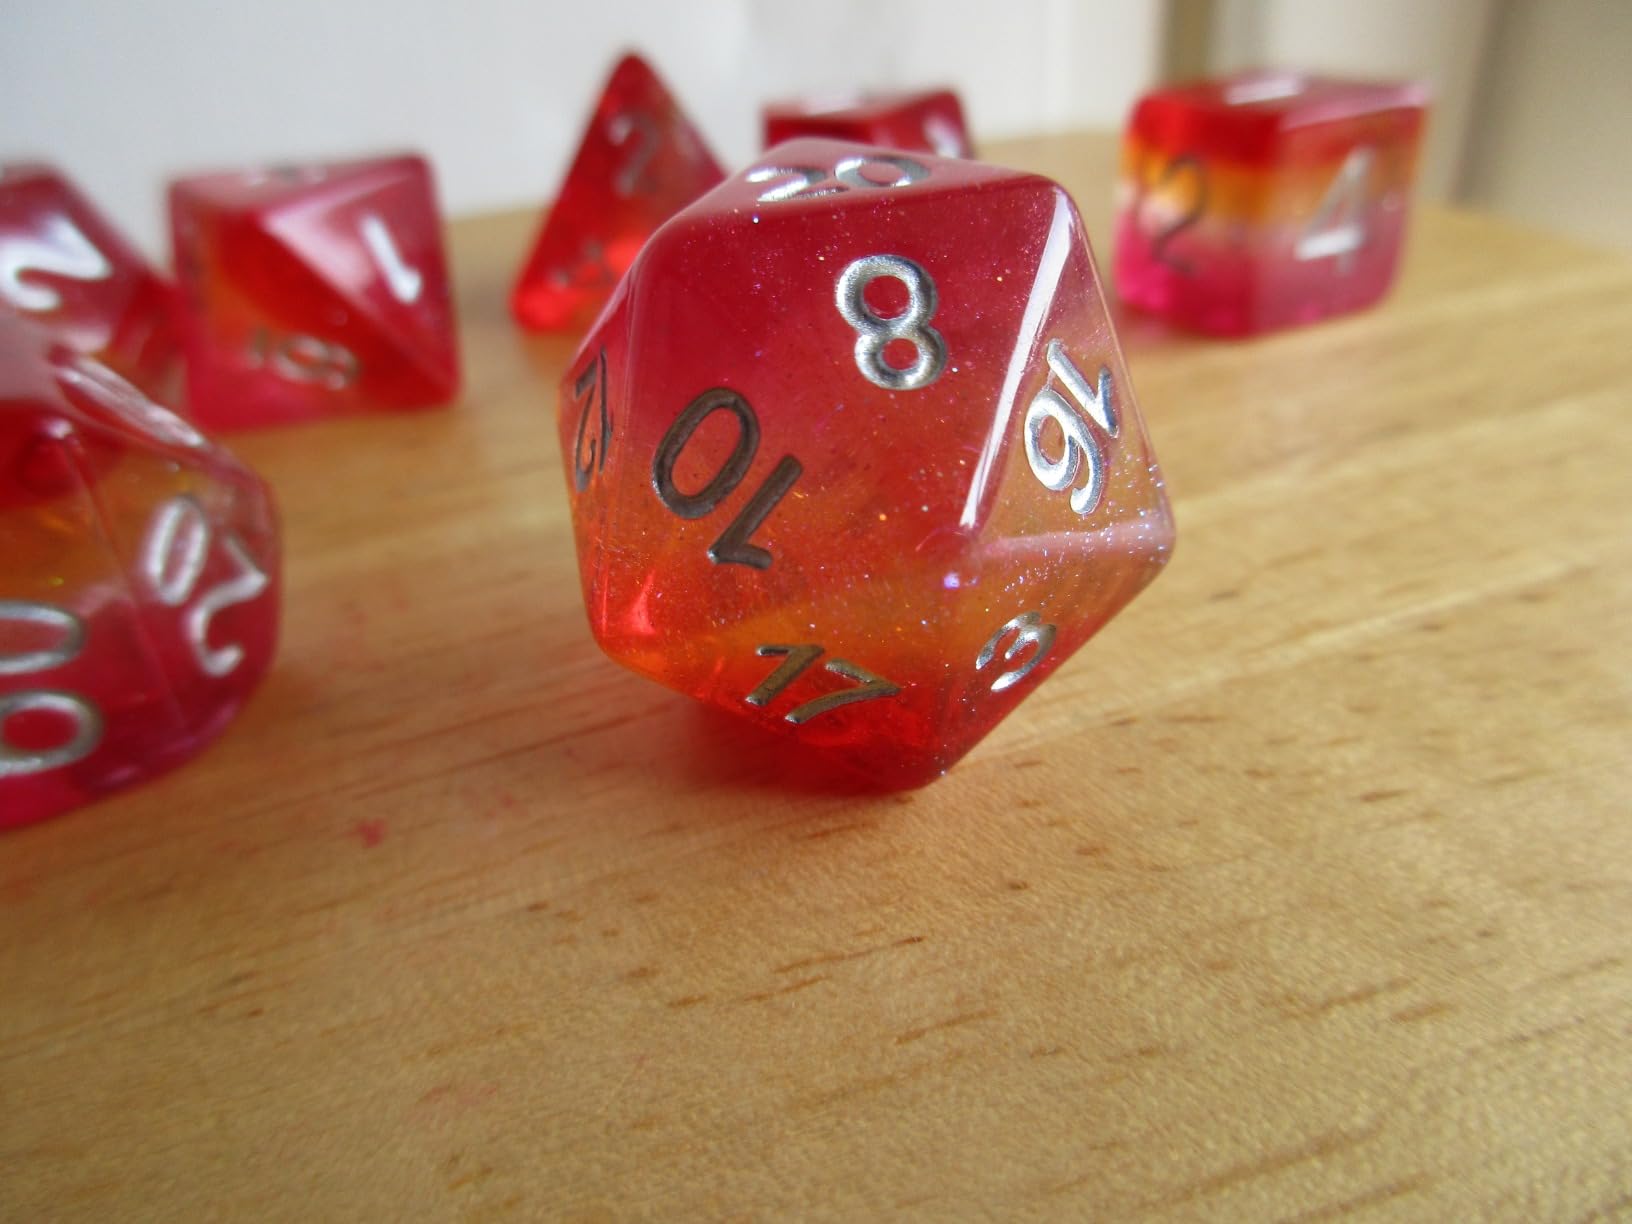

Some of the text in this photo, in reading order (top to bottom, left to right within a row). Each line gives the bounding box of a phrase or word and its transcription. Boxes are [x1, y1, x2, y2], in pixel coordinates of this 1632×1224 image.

[746, 154, 931, 202] 20
[835, 253, 947, 391] 8
[652, 386, 804, 571] 10
[1023, 337, 1119, 516] 16
[145, 495, 268, 677] 20
[975, 611, 1057, 693] 3
[744, 643, 901, 725] 17
